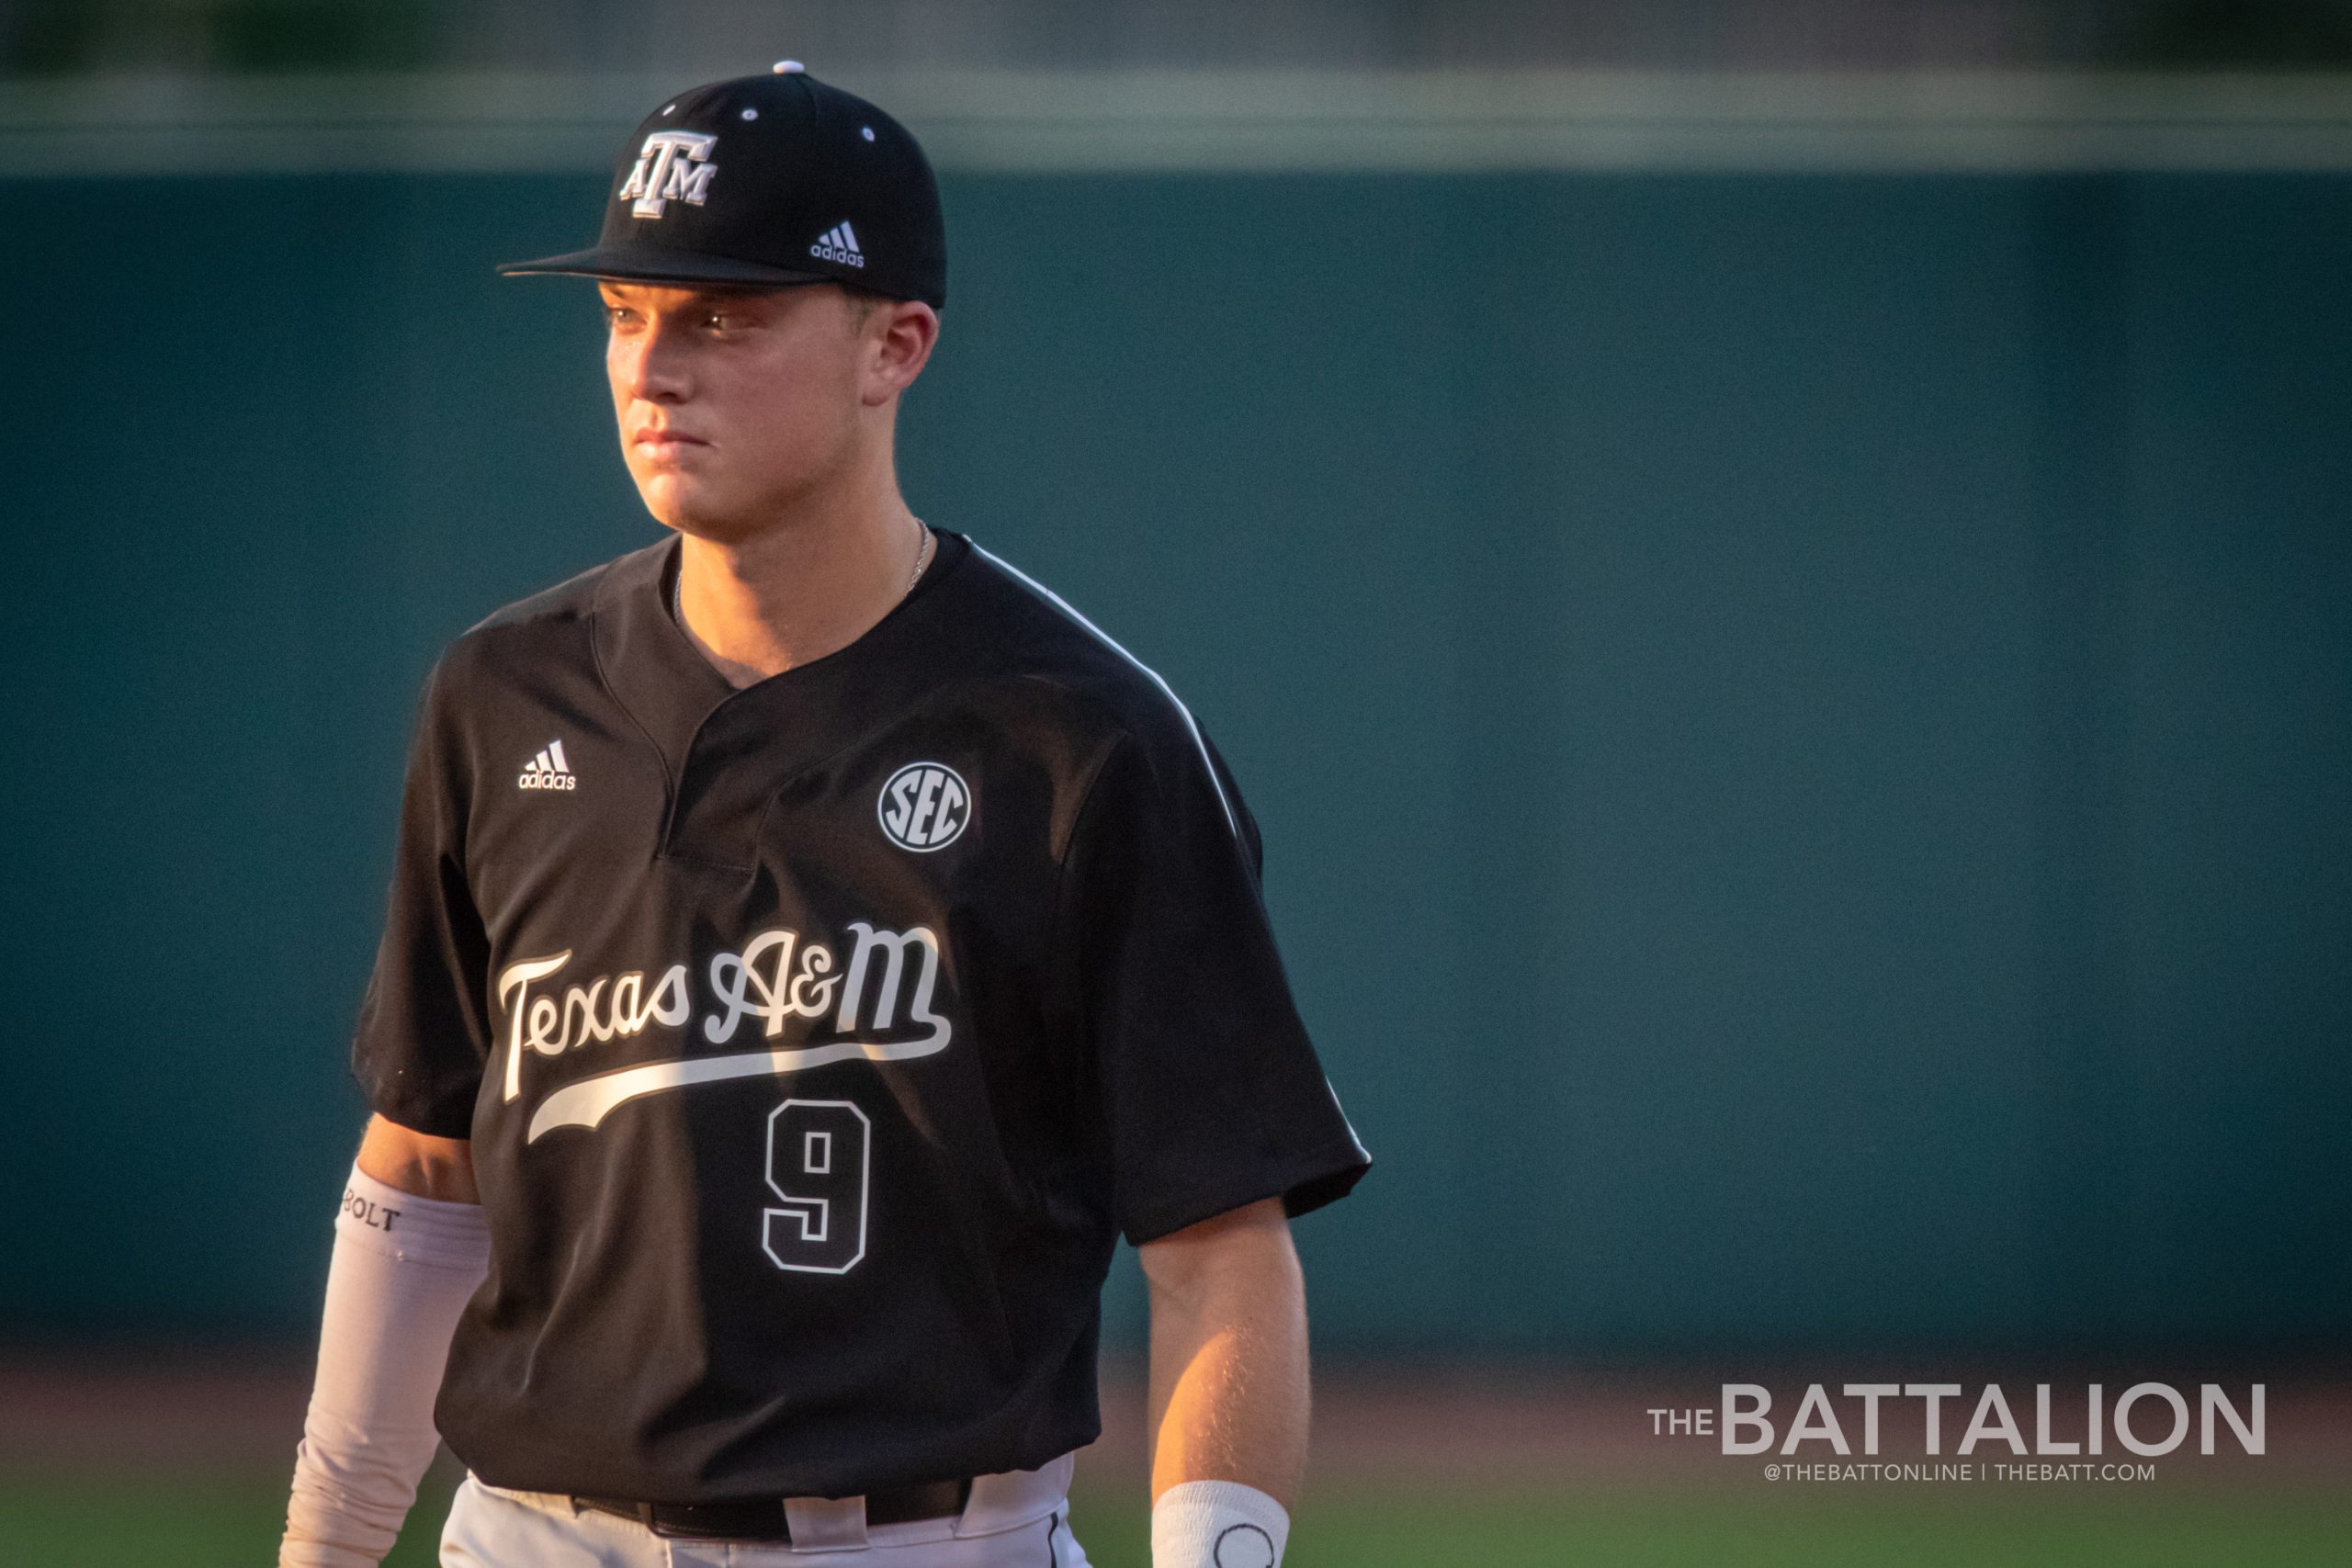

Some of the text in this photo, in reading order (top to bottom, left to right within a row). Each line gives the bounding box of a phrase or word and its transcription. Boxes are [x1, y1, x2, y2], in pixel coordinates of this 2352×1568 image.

[810, 240, 865, 269] adidas
[518, 769, 576, 791] adidas
[885, 769, 965, 845] SEC
[498, 921, 953, 1103] Texas A&M
[761, 1098, 871, 1275] 9
